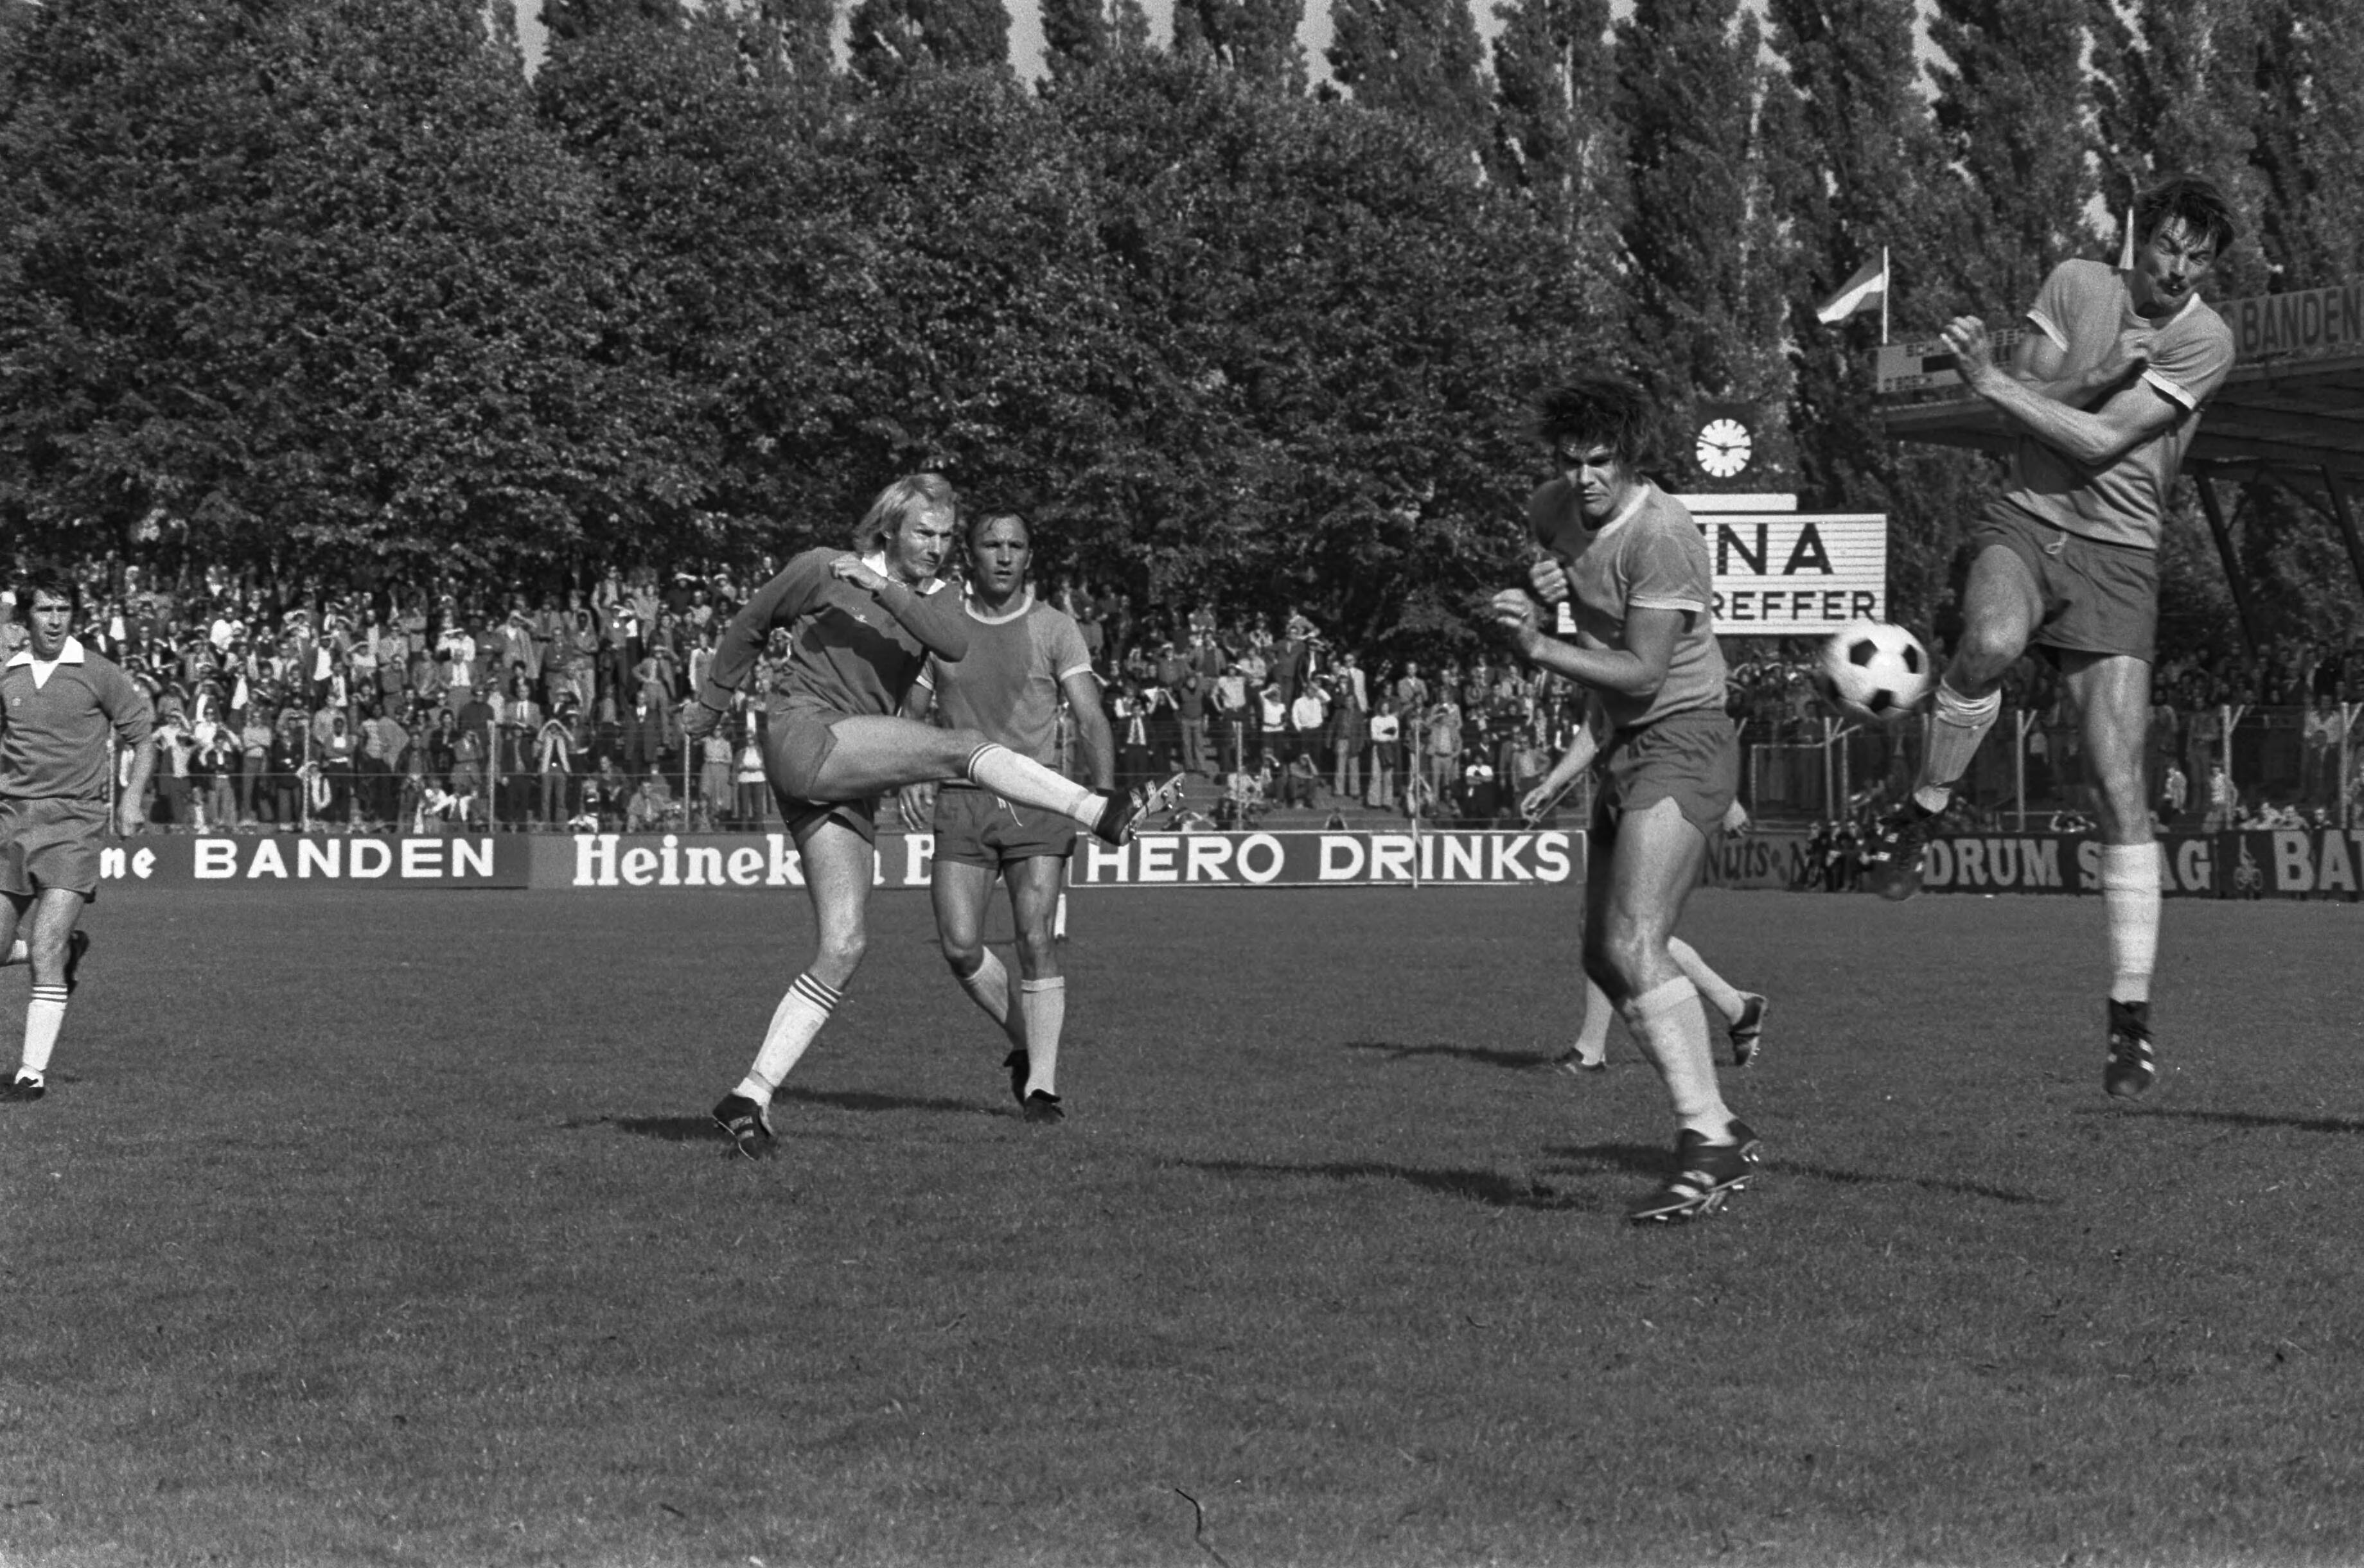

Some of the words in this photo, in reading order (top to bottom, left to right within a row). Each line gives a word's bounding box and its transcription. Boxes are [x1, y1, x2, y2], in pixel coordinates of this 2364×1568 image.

[2241, 286, 2362, 352] BANDEN
[1696, 523, 1834, 576] NA
[194, 838, 494, 878] BANDEN
[572, 833, 885, 886] Heinek
[1086, 833, 1285, 883] HERO
[1318, 832, 1570, 883] DRINKS
[1924, 838, 2062, 886] DRUM
